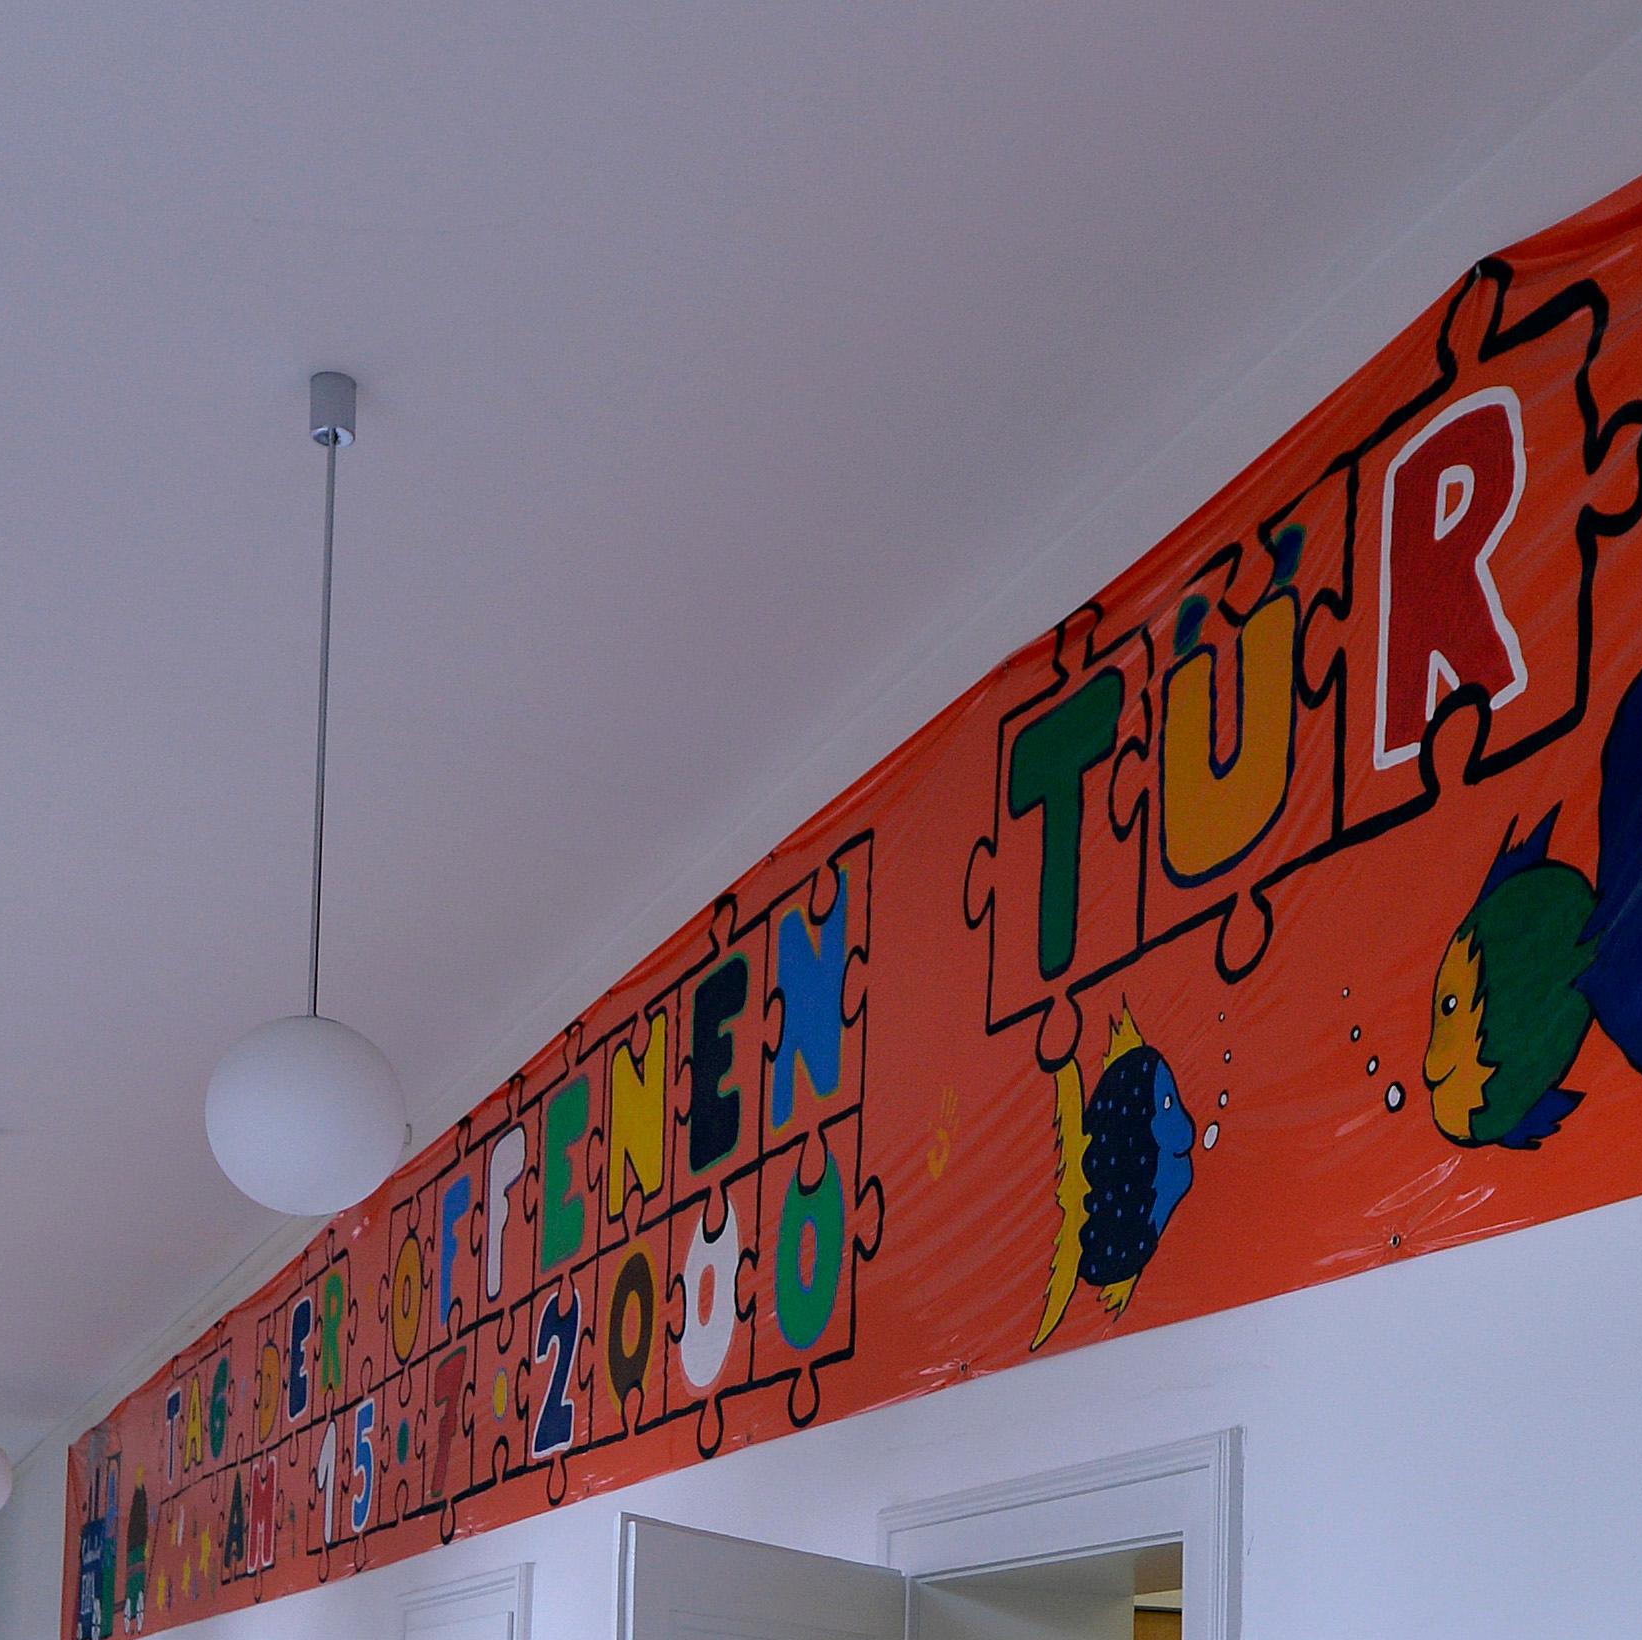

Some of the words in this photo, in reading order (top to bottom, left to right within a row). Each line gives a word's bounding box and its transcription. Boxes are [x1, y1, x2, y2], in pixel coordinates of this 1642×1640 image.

[165, 1357, 229, 1485] TAG
[258, 1268, 345, 1443] DER
[391, 865, 849, 1365] OFFENEN
[1009, 385, 1529, 980] TÜR
[223, 1455, 278, 1574] AM
